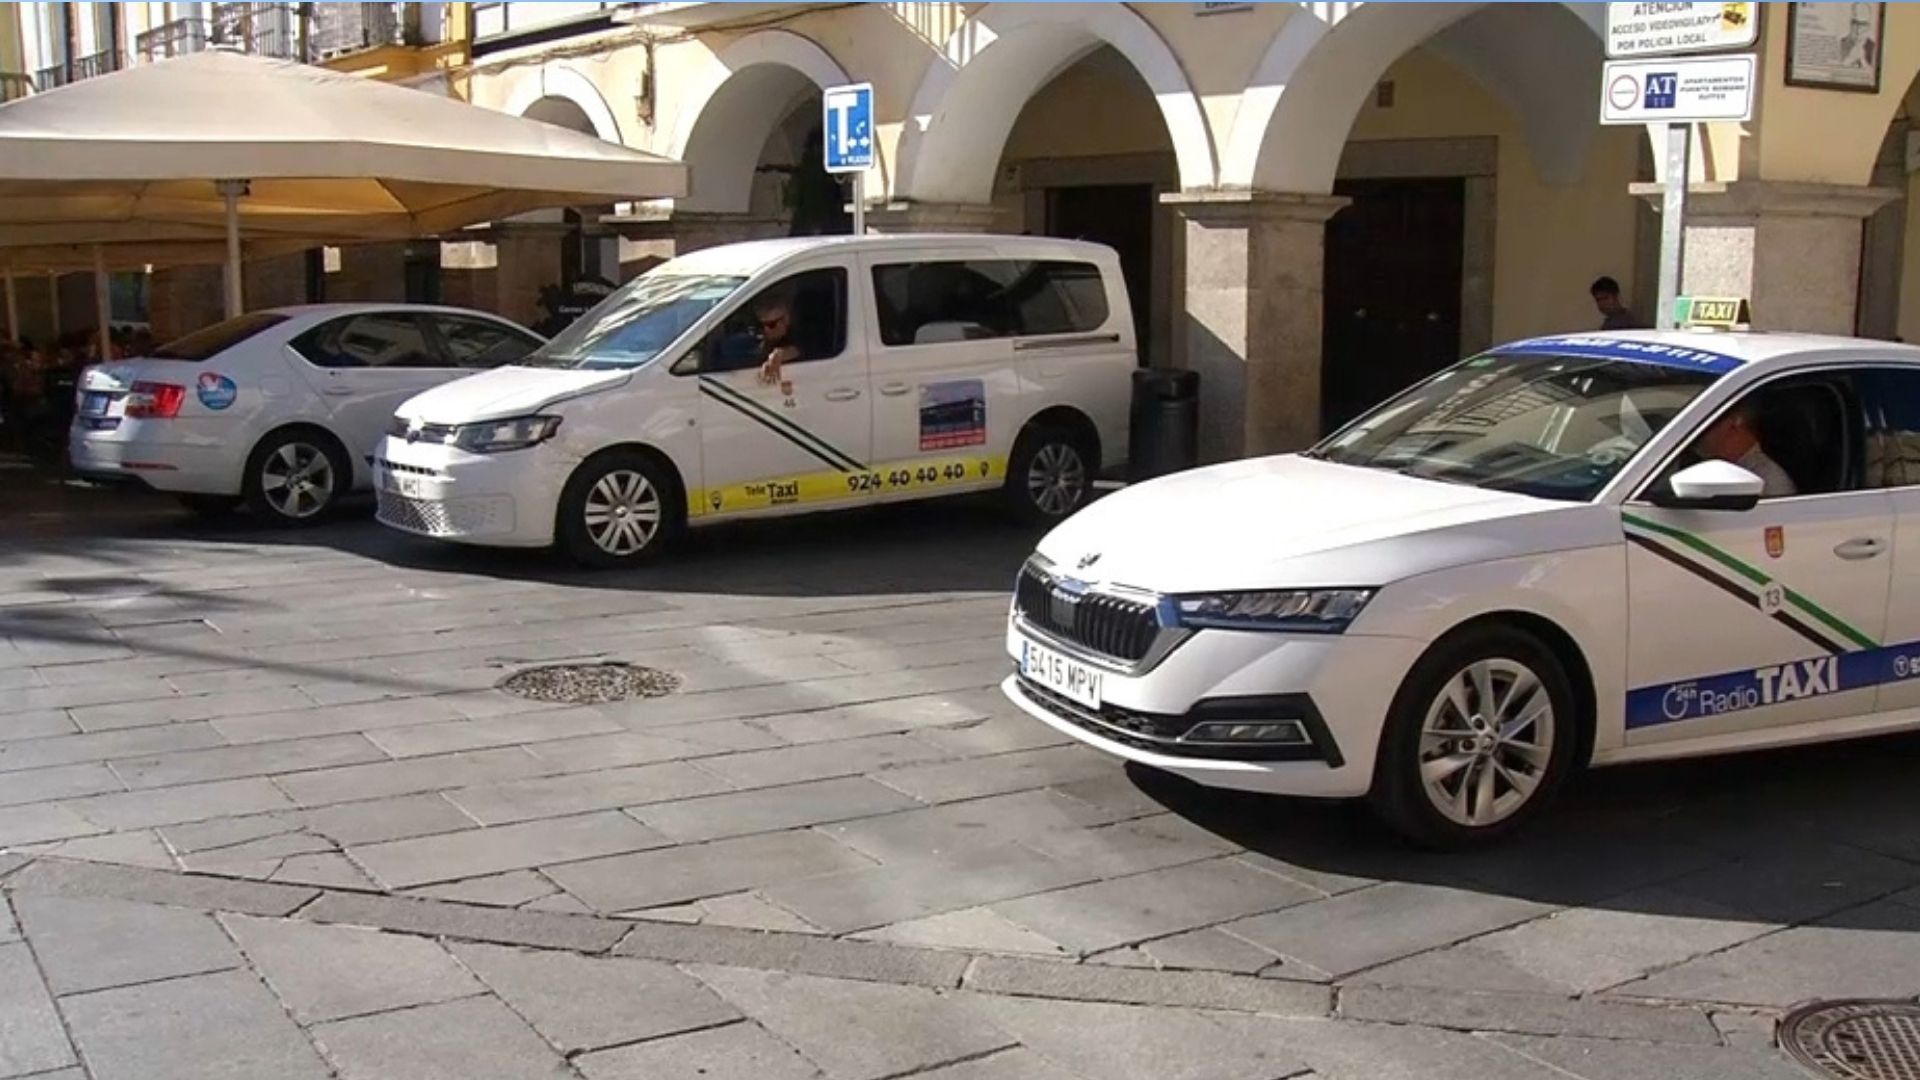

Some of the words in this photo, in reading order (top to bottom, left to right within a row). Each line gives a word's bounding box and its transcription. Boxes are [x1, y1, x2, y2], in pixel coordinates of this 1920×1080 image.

[1611, 22, 1646, 36] ACCESO
[1617, 41, 1635, 50] POR
[1677, 33, 1706, 45] LOCAL
[1646, 76, 1677, 95] AT
[828, 93, 858, 155] T
[1700, 303, 1733, 319] TAXI
[847, 473, 882, 492] 924
[888, 469, 911, 487] 40
[915, 466, 938, 483] 40
[942, 463, 965, 480] 40
[766, 479, 799, 498] Taxi
[1765, 588, 1781, 607] 13
[1030, 646, 1063, 685] 5415
[1067, 663, 1098, 701] MPV
[1676, 687, 1698, 702] 24h
